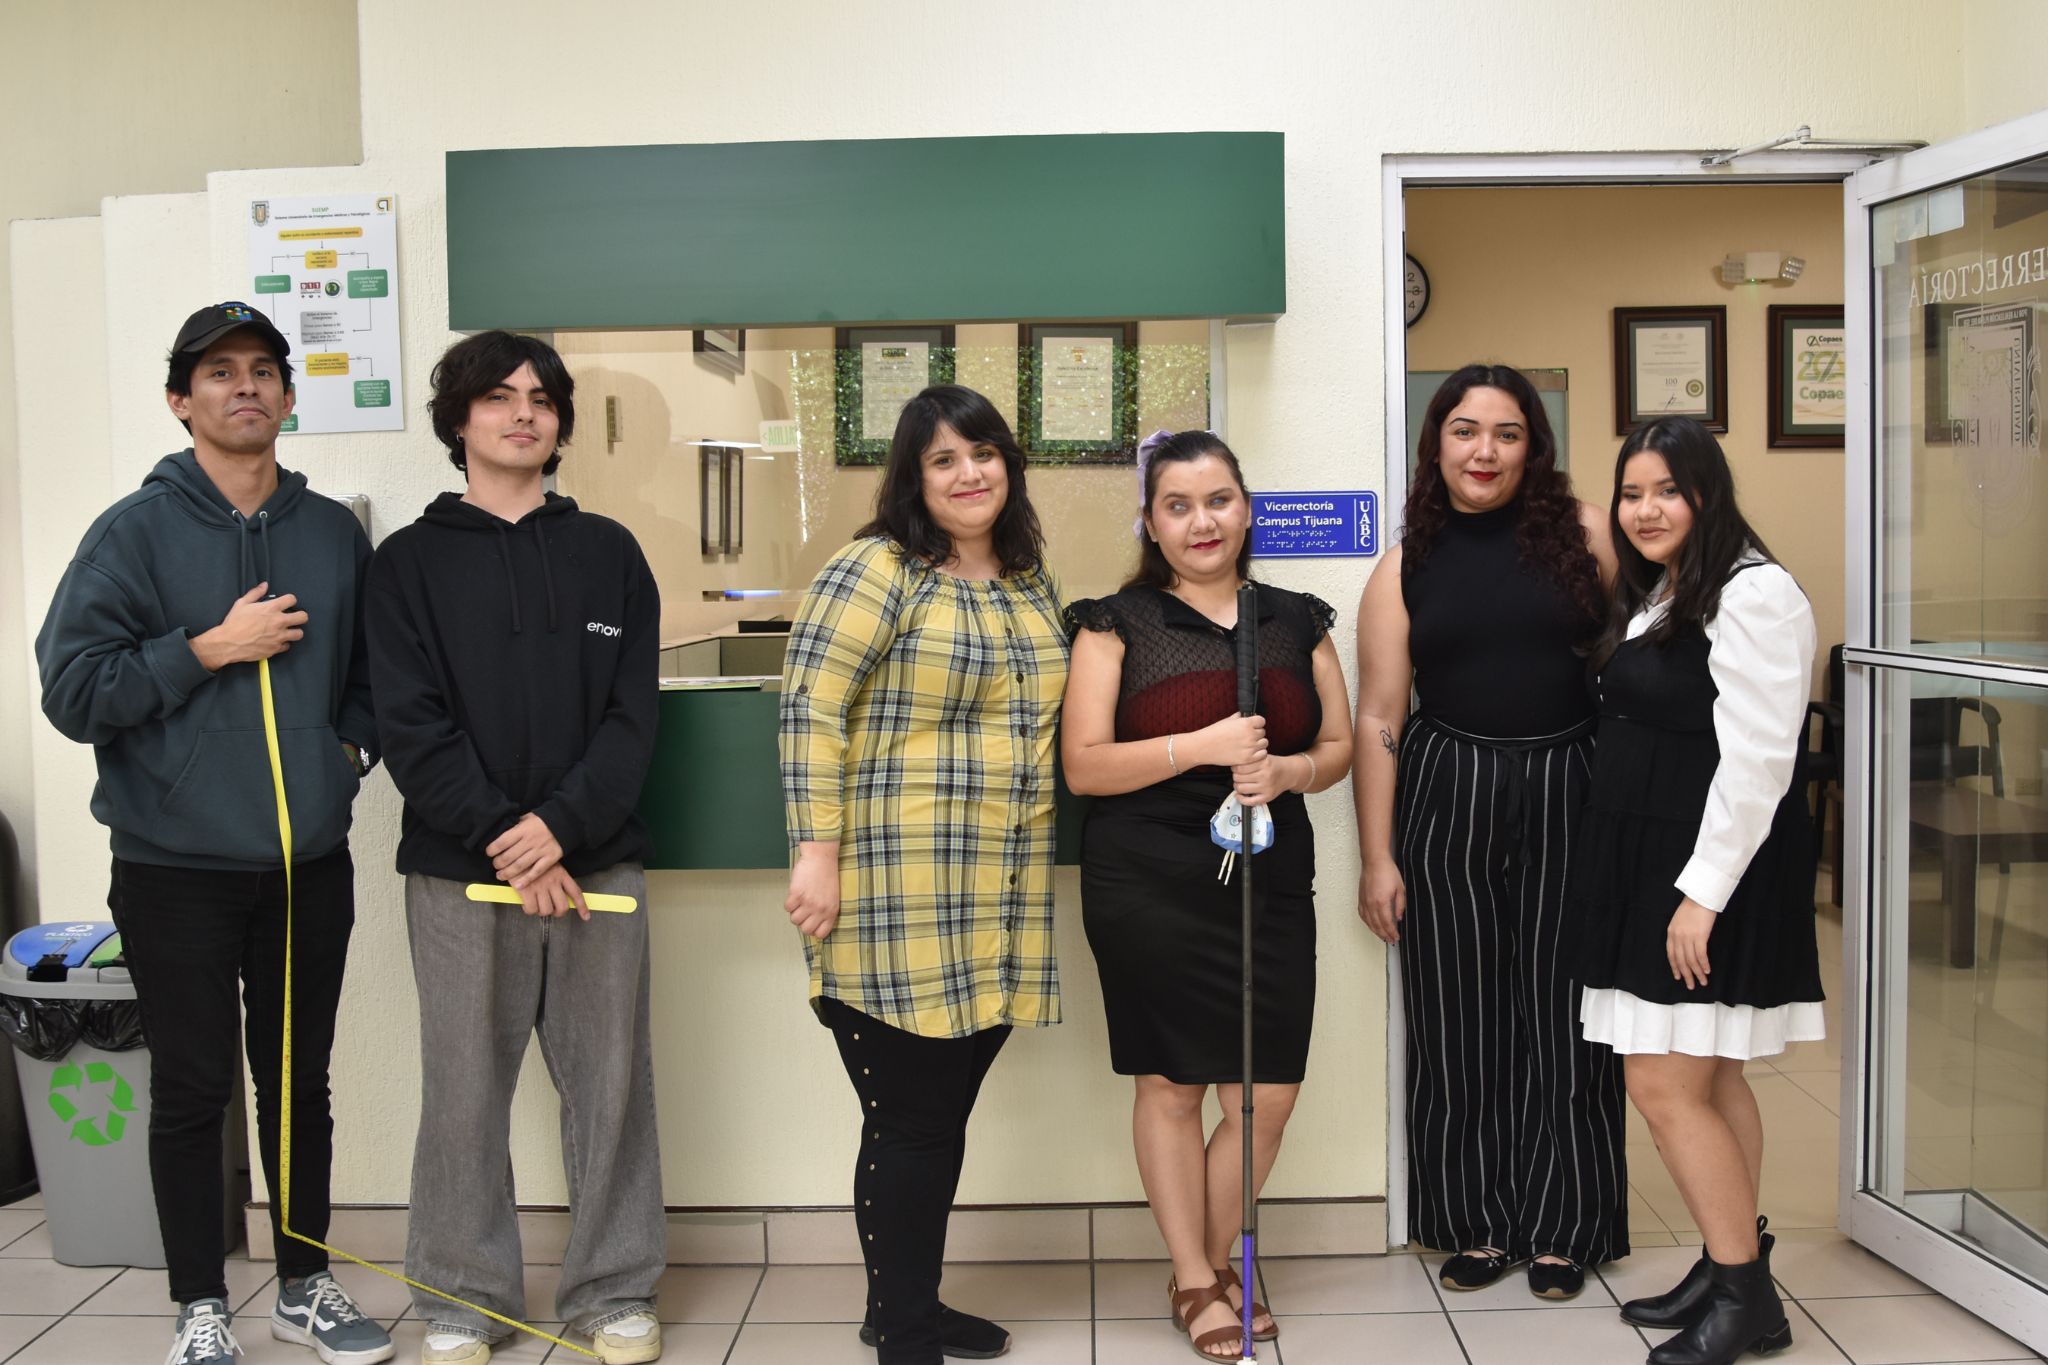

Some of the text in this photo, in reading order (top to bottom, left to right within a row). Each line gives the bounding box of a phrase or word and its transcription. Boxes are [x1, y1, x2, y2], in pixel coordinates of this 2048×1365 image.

[1407, 272, 1415, 282] 2
[1408, 300, 1416, 311] 4
[1799, 386, 1845, 402] Copae
[1264, 501, 1334, 512] Vicerrectoría
[1256, 515, 1343, 528] Campus Tijuana
[1359, 501, 1371, 547] UABC
[587, 622, 622, 638] enov
